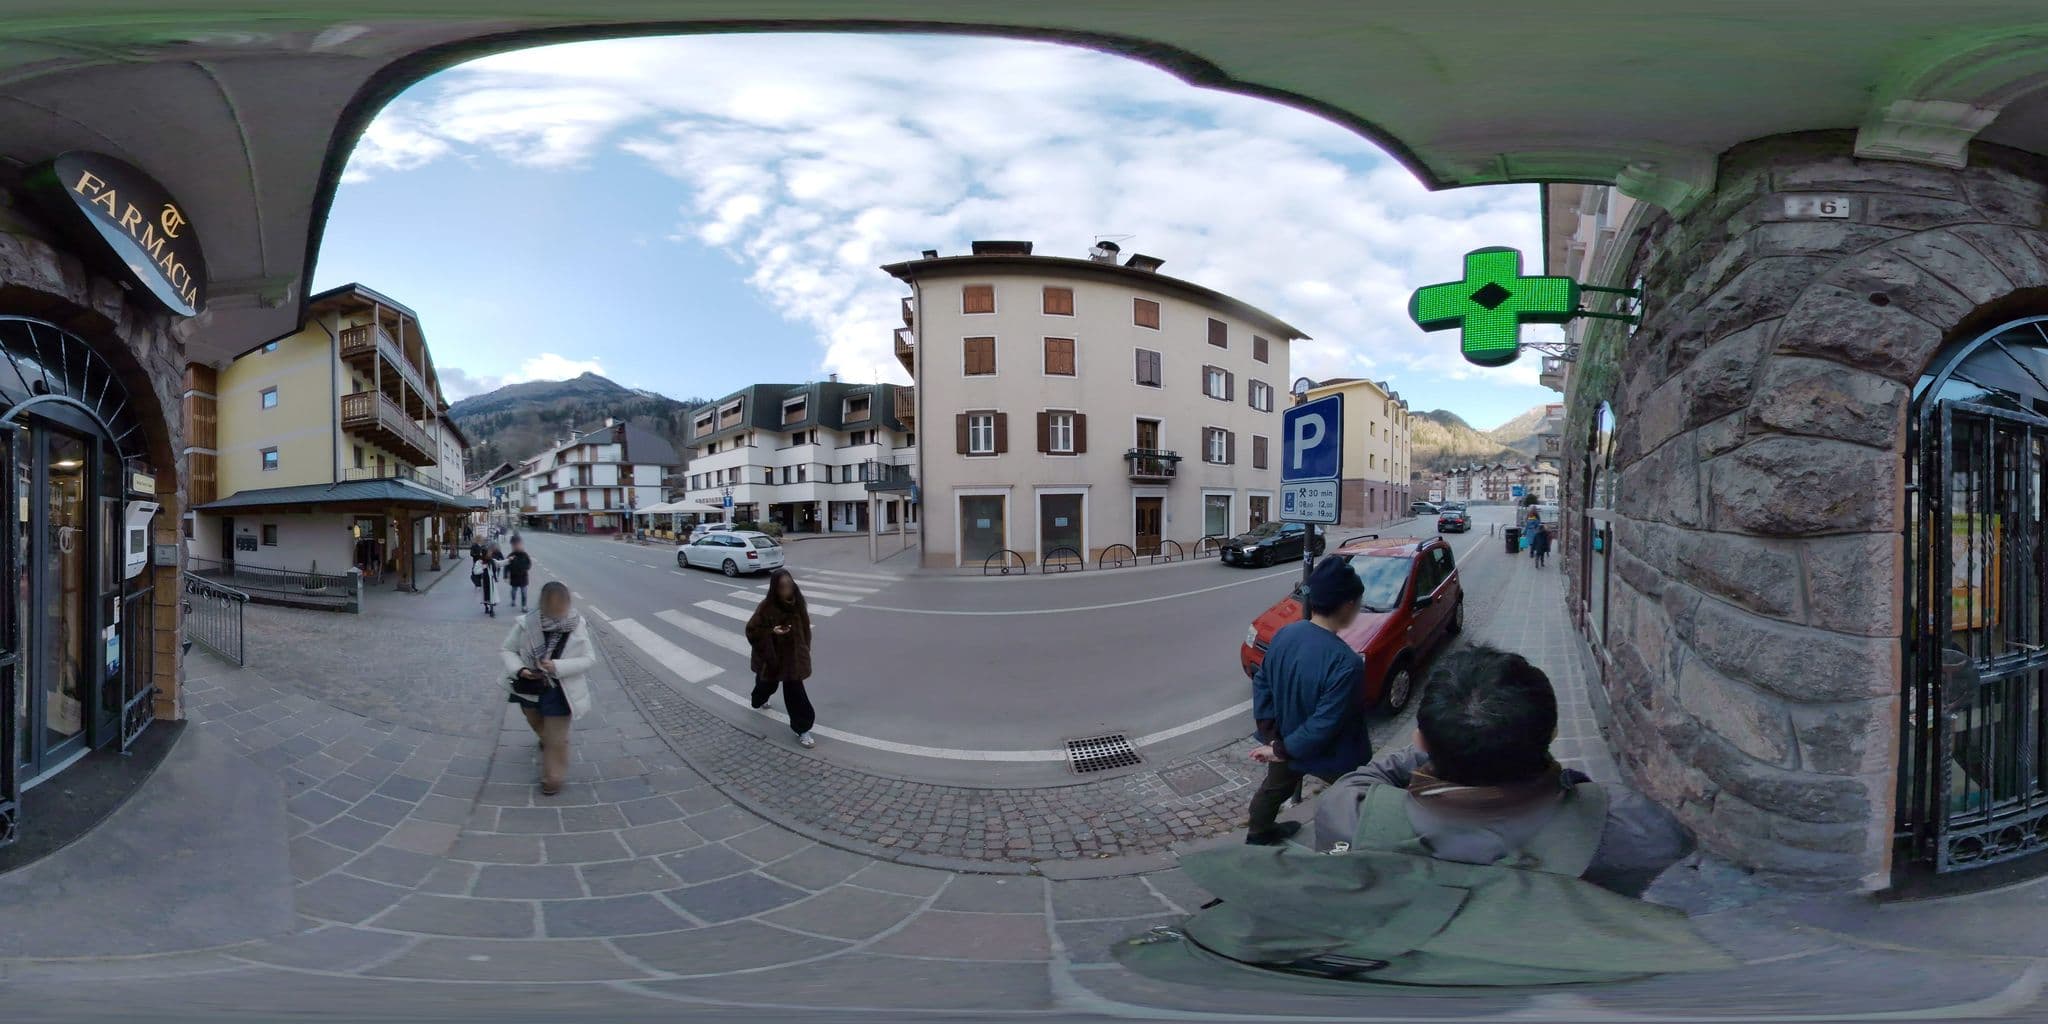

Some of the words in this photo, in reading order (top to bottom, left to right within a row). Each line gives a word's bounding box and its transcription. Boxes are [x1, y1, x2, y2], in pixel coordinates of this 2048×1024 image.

[73, 169, 198, 309] FARMACIA
[1293, 412, 1326, 470] P
[1308, 489, 1319, 497] 30
